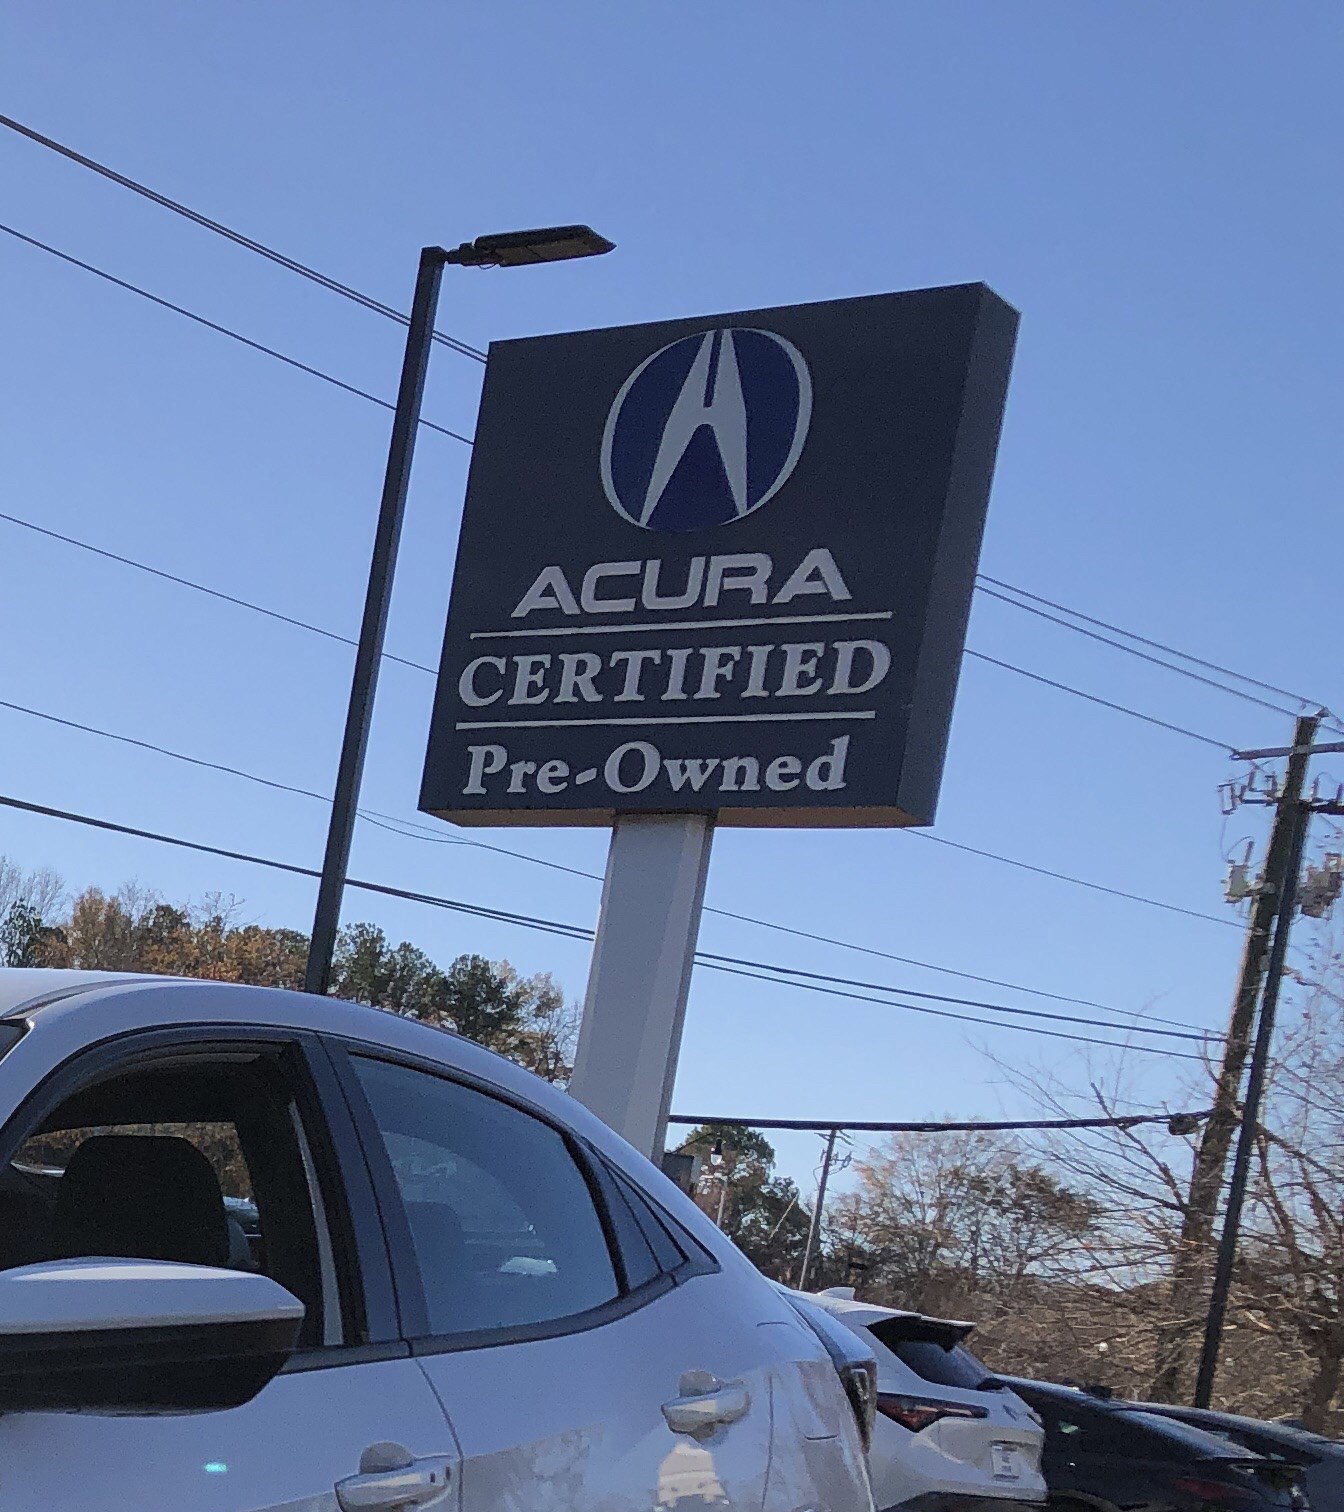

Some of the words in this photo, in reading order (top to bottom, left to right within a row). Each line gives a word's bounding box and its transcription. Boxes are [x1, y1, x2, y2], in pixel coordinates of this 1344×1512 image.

[511, 548, 852, 618] ACURA
[458, 639, 892, 707] CERTIFIED
[462, 735, 851, 795] Pre-Owned
